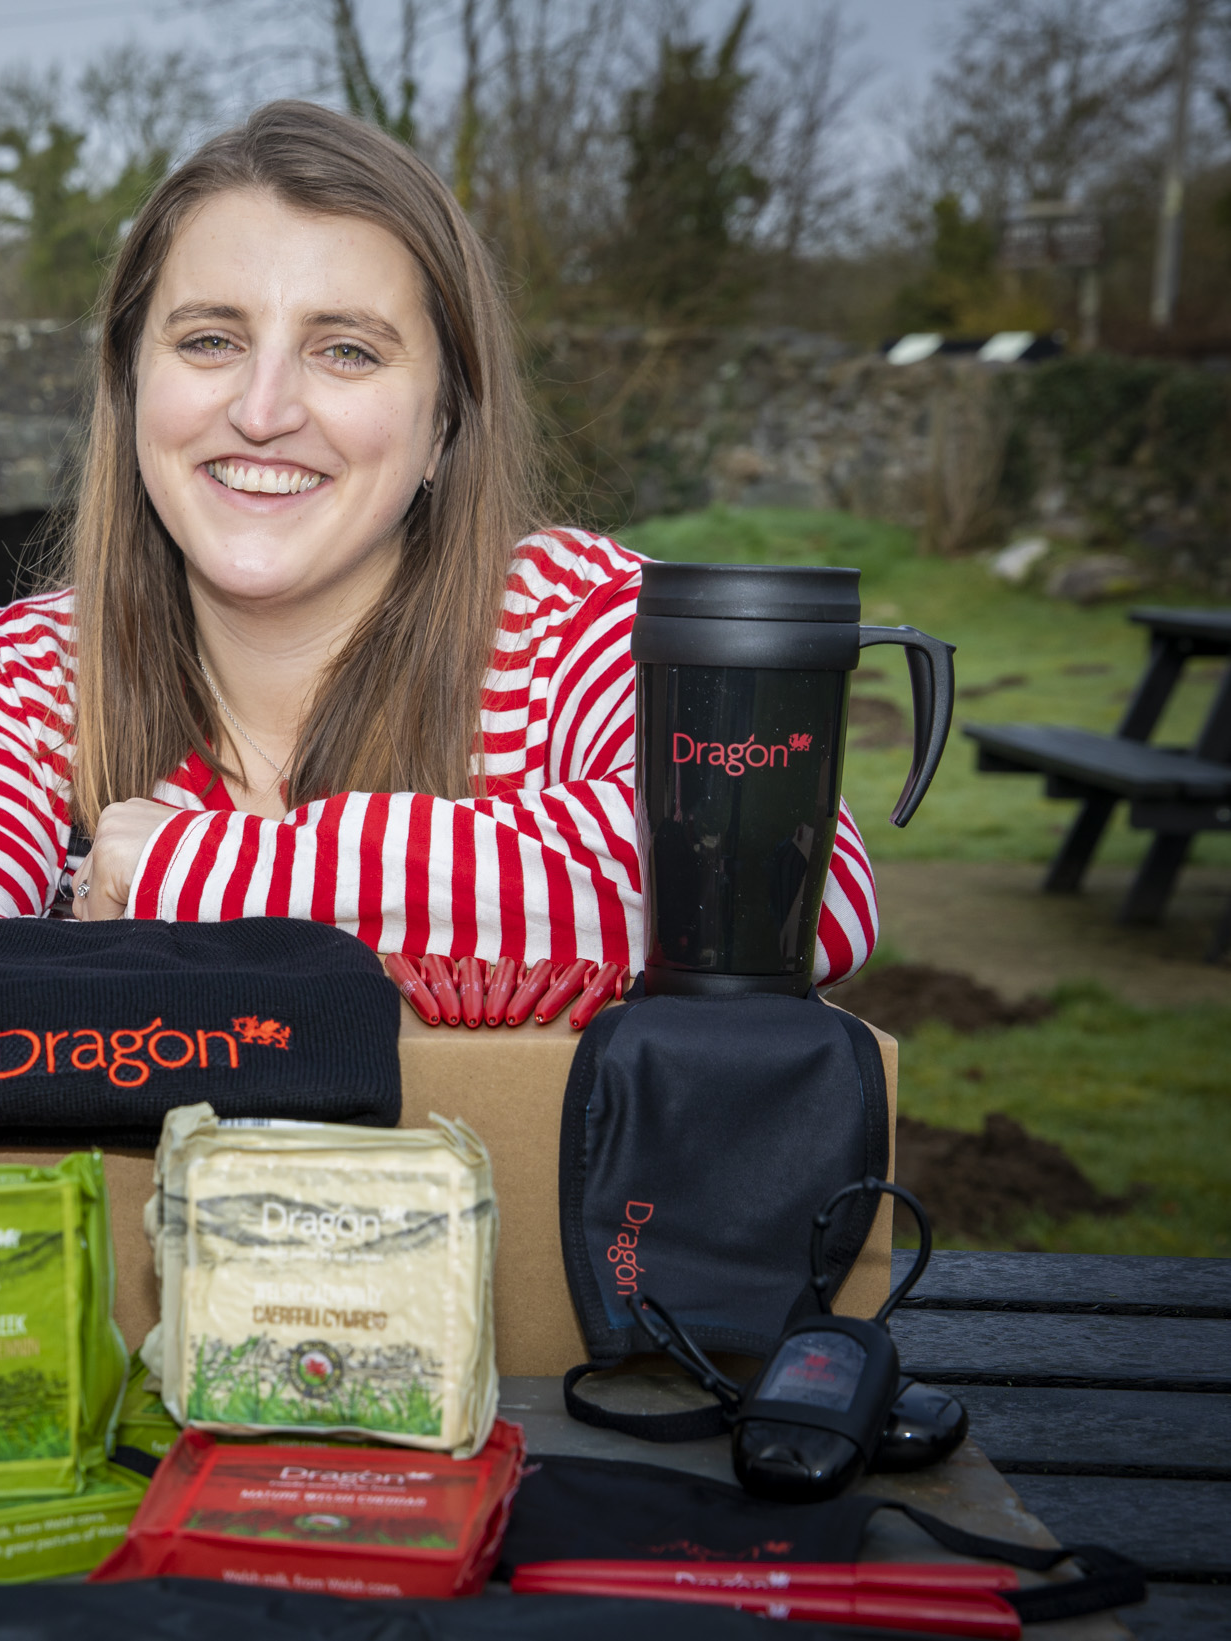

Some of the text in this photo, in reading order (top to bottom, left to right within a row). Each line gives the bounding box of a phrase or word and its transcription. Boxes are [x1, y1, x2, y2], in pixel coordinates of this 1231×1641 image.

[673, 733, 788, 776] Dragon
[262, 1201, 381, 1247] Dragon
[607, 1200, 654, 1295] Dragon
[280, 1466, 405, 1486] Dragon
